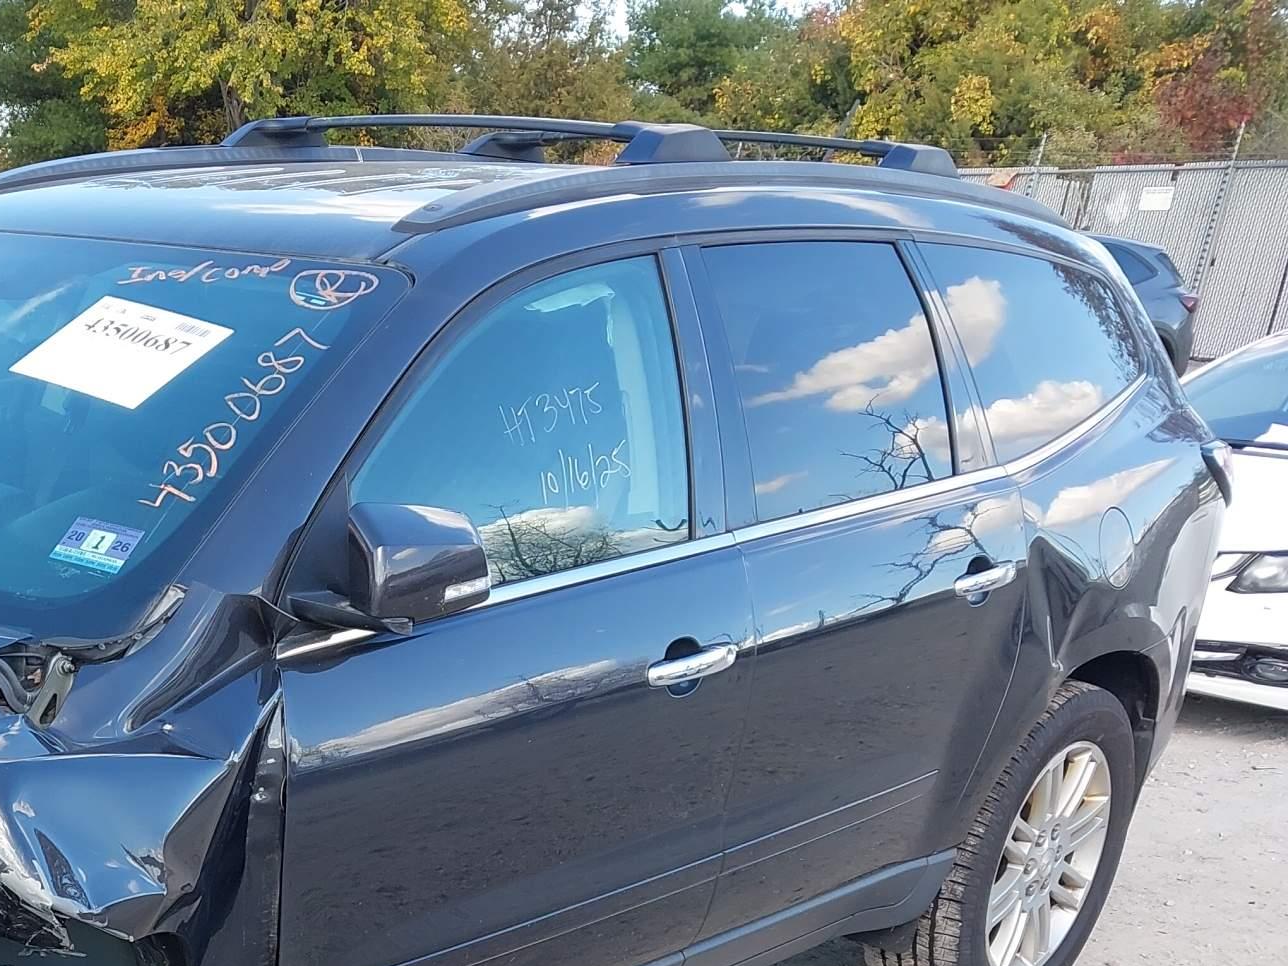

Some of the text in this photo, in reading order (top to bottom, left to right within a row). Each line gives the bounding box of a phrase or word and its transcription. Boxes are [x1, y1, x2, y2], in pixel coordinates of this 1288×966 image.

[84, 317, 193, 355] 43500687
[137, 327, 331, 508] 43500687
[540, 439, 632, 512] 10/16/25
[67, 530, 132, 553] 20 1 26
